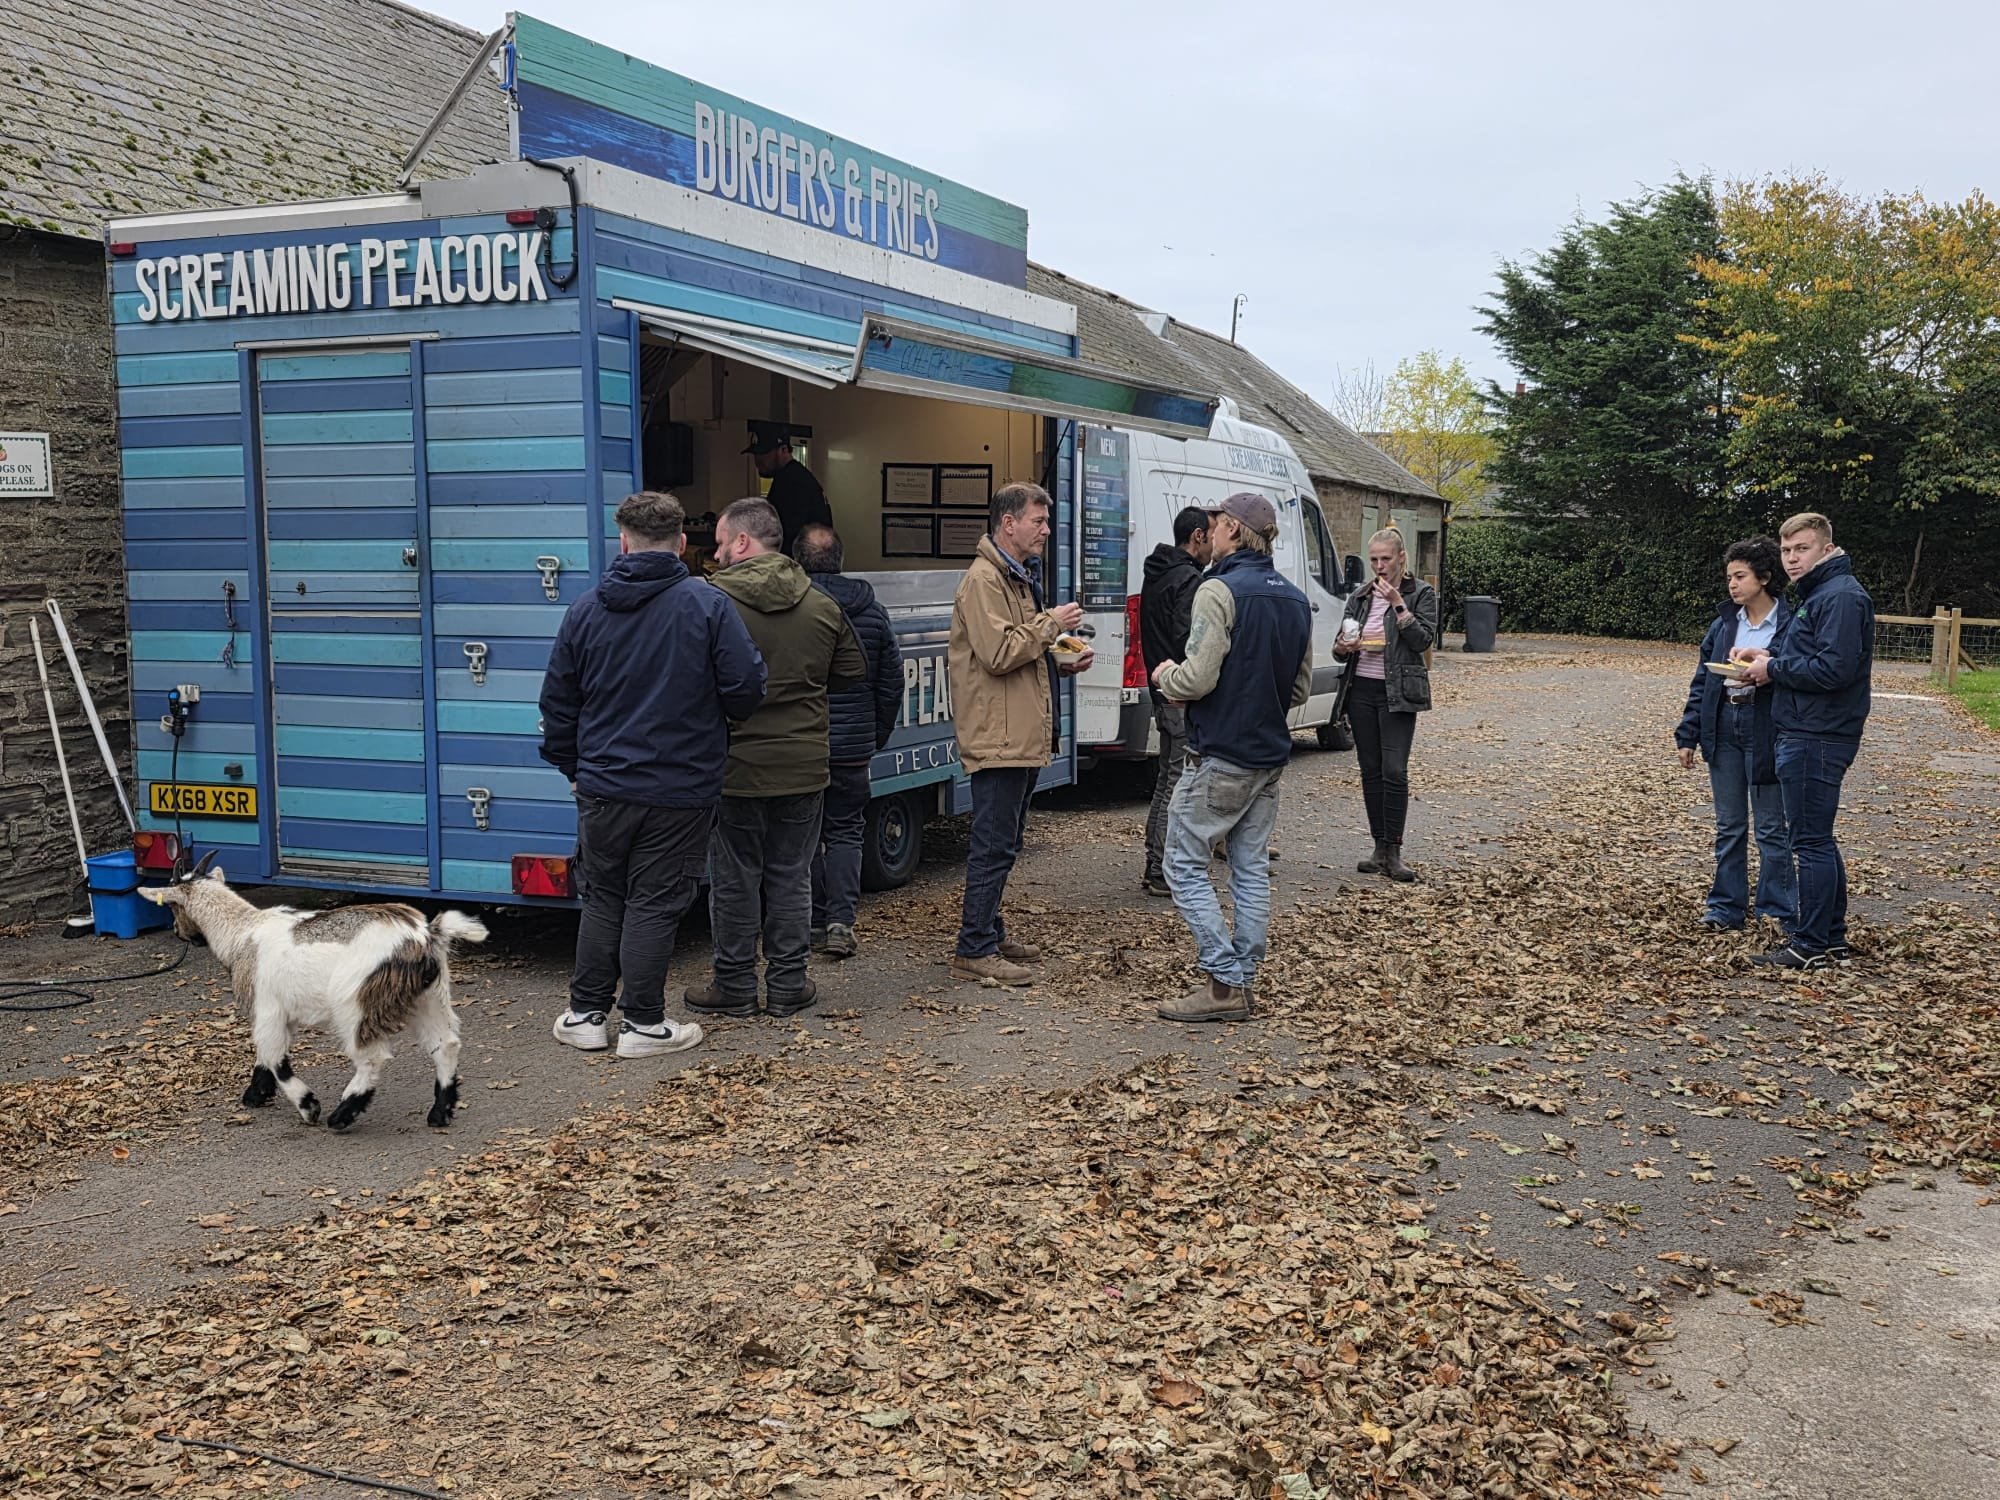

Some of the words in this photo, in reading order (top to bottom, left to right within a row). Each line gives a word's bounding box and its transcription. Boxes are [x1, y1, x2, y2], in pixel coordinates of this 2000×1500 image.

[695, 101, 836, 228] BURGERS
[844, 158, 863, 239] &
[870, 165, 939, 260] FRIES
[136, 243, 351, 322] SCREAMING
[361, 232, 548, 307] PEACOCK
[1100, 437, 1116, 457] MENU
[0, 477, 36, 485] PLEASE
[17, 465, 32, 473] ON
[904, 656, 953, 727] PEA
[158, 788, 206, 811] KX68
[212, 790, 249, 813] XSR
